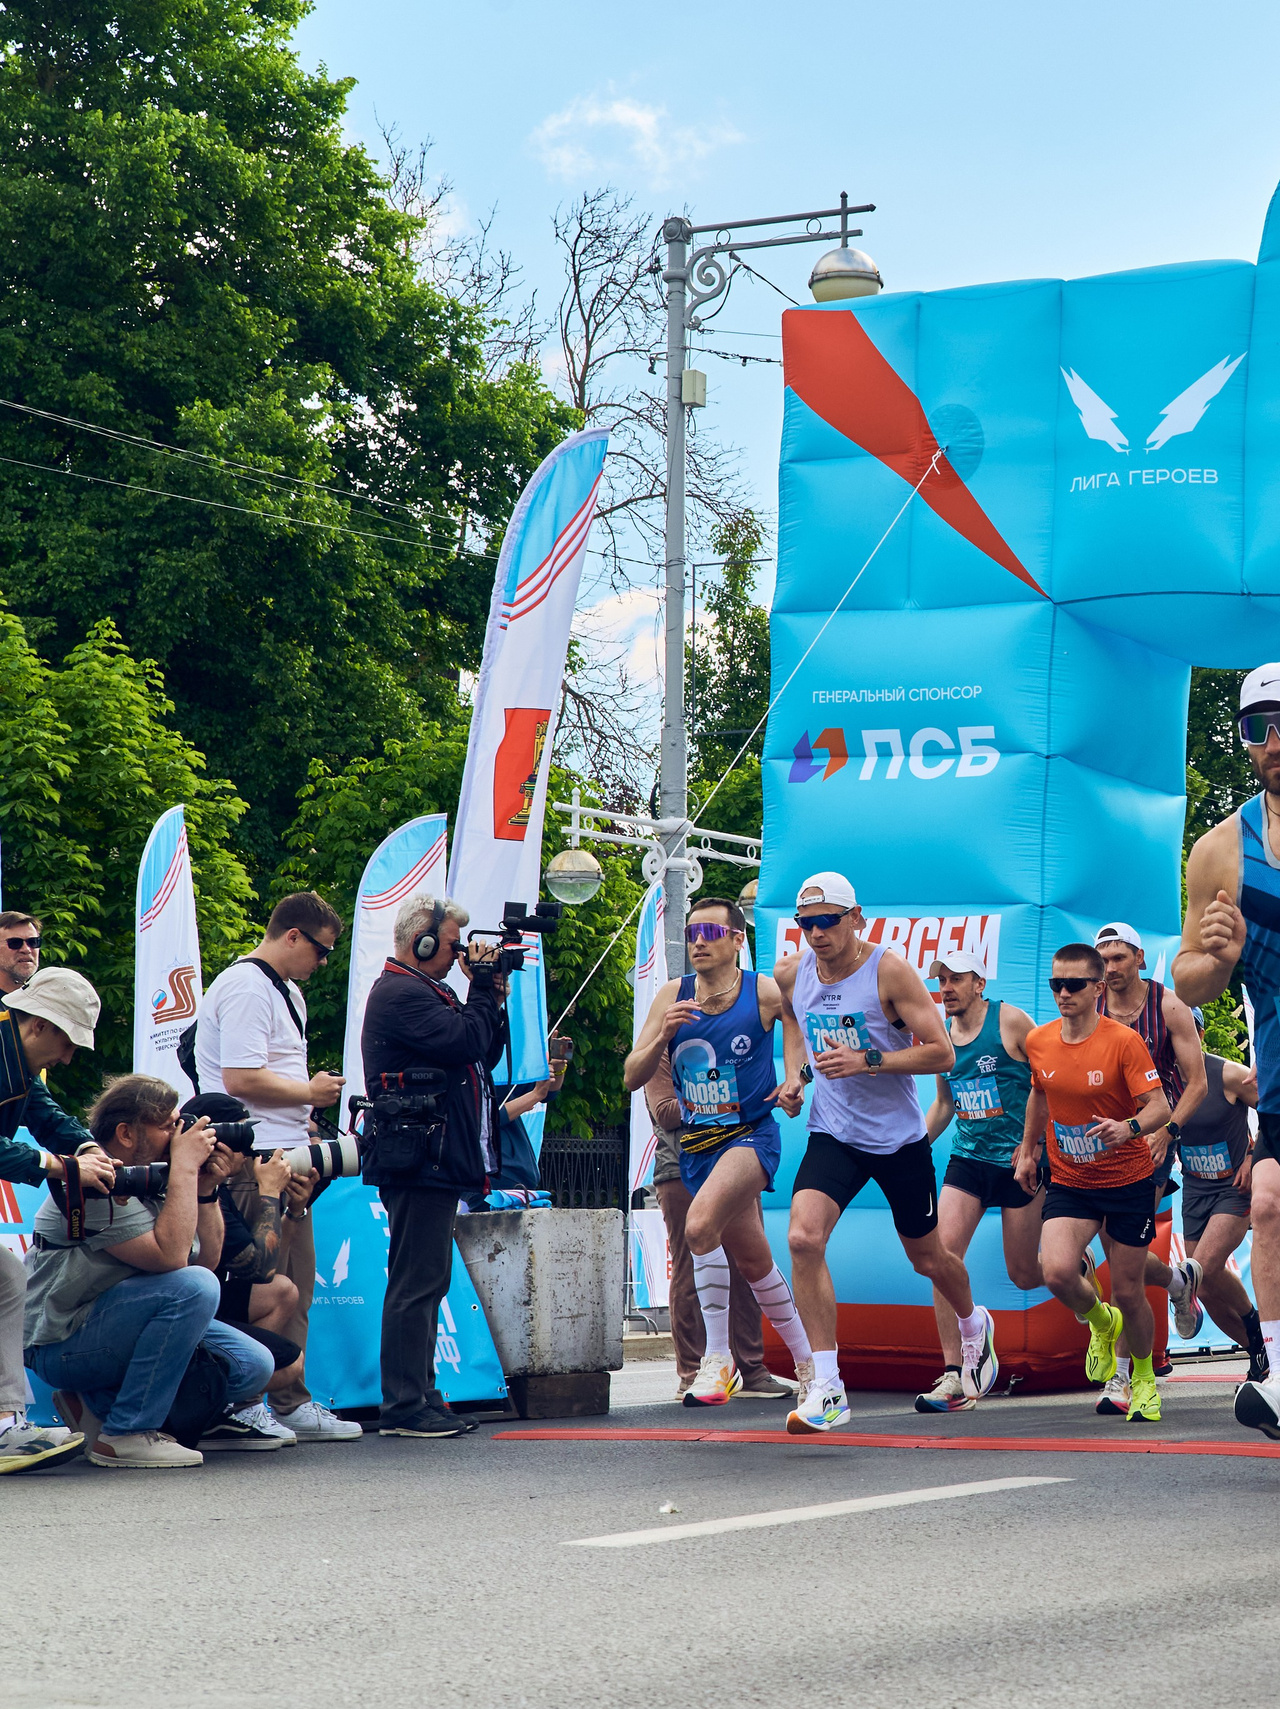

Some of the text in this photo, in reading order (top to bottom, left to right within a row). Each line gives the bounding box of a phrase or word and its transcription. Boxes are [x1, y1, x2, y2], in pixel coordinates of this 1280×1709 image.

[1070, 468, 1219, 493] ЛИГА ГЕРОЕВ
[812, 685, 982, 704] ГЕНЕРАЛЬНЫЙ СПОНСОР
[859, 725, 1001, 781] ПСБ
[979, 1063, 997, 1074] KRC
[683, 1080, 731, 1104] 70083
[956, 1088, 994, 1111] 70271
[356, 1100, 374, 1108] RONIN
[1186, 1153, 1227, 1172] 70288
[71, 1208, 81, 1238] Canon
[312, 1296, 365, 1306] ИГА ГЕРОЕВ
